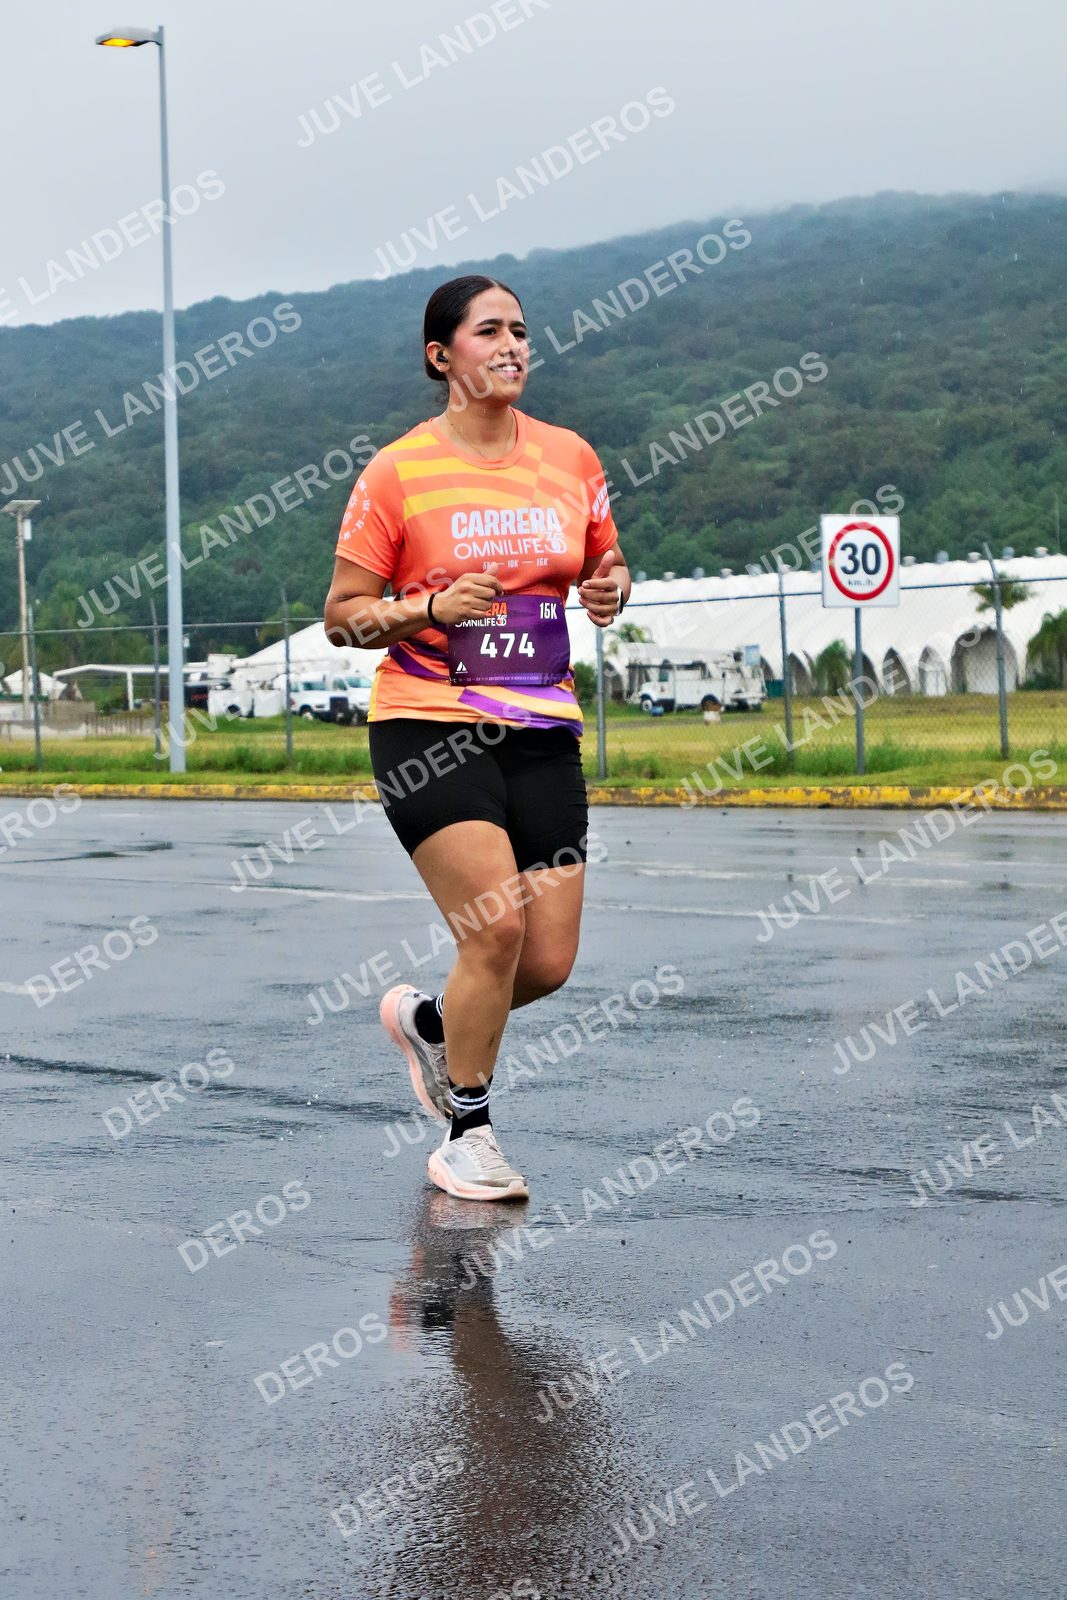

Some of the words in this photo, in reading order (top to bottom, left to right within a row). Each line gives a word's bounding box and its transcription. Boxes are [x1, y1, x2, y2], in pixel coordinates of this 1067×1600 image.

[451, 508, 562, 539] CARRERA
[454, 538, 544, 559] OMNILIFE
[840, 543, 882, 575] 30
[540, 602, 558, 620] 15K
[480, 633, 535, 658] 474
